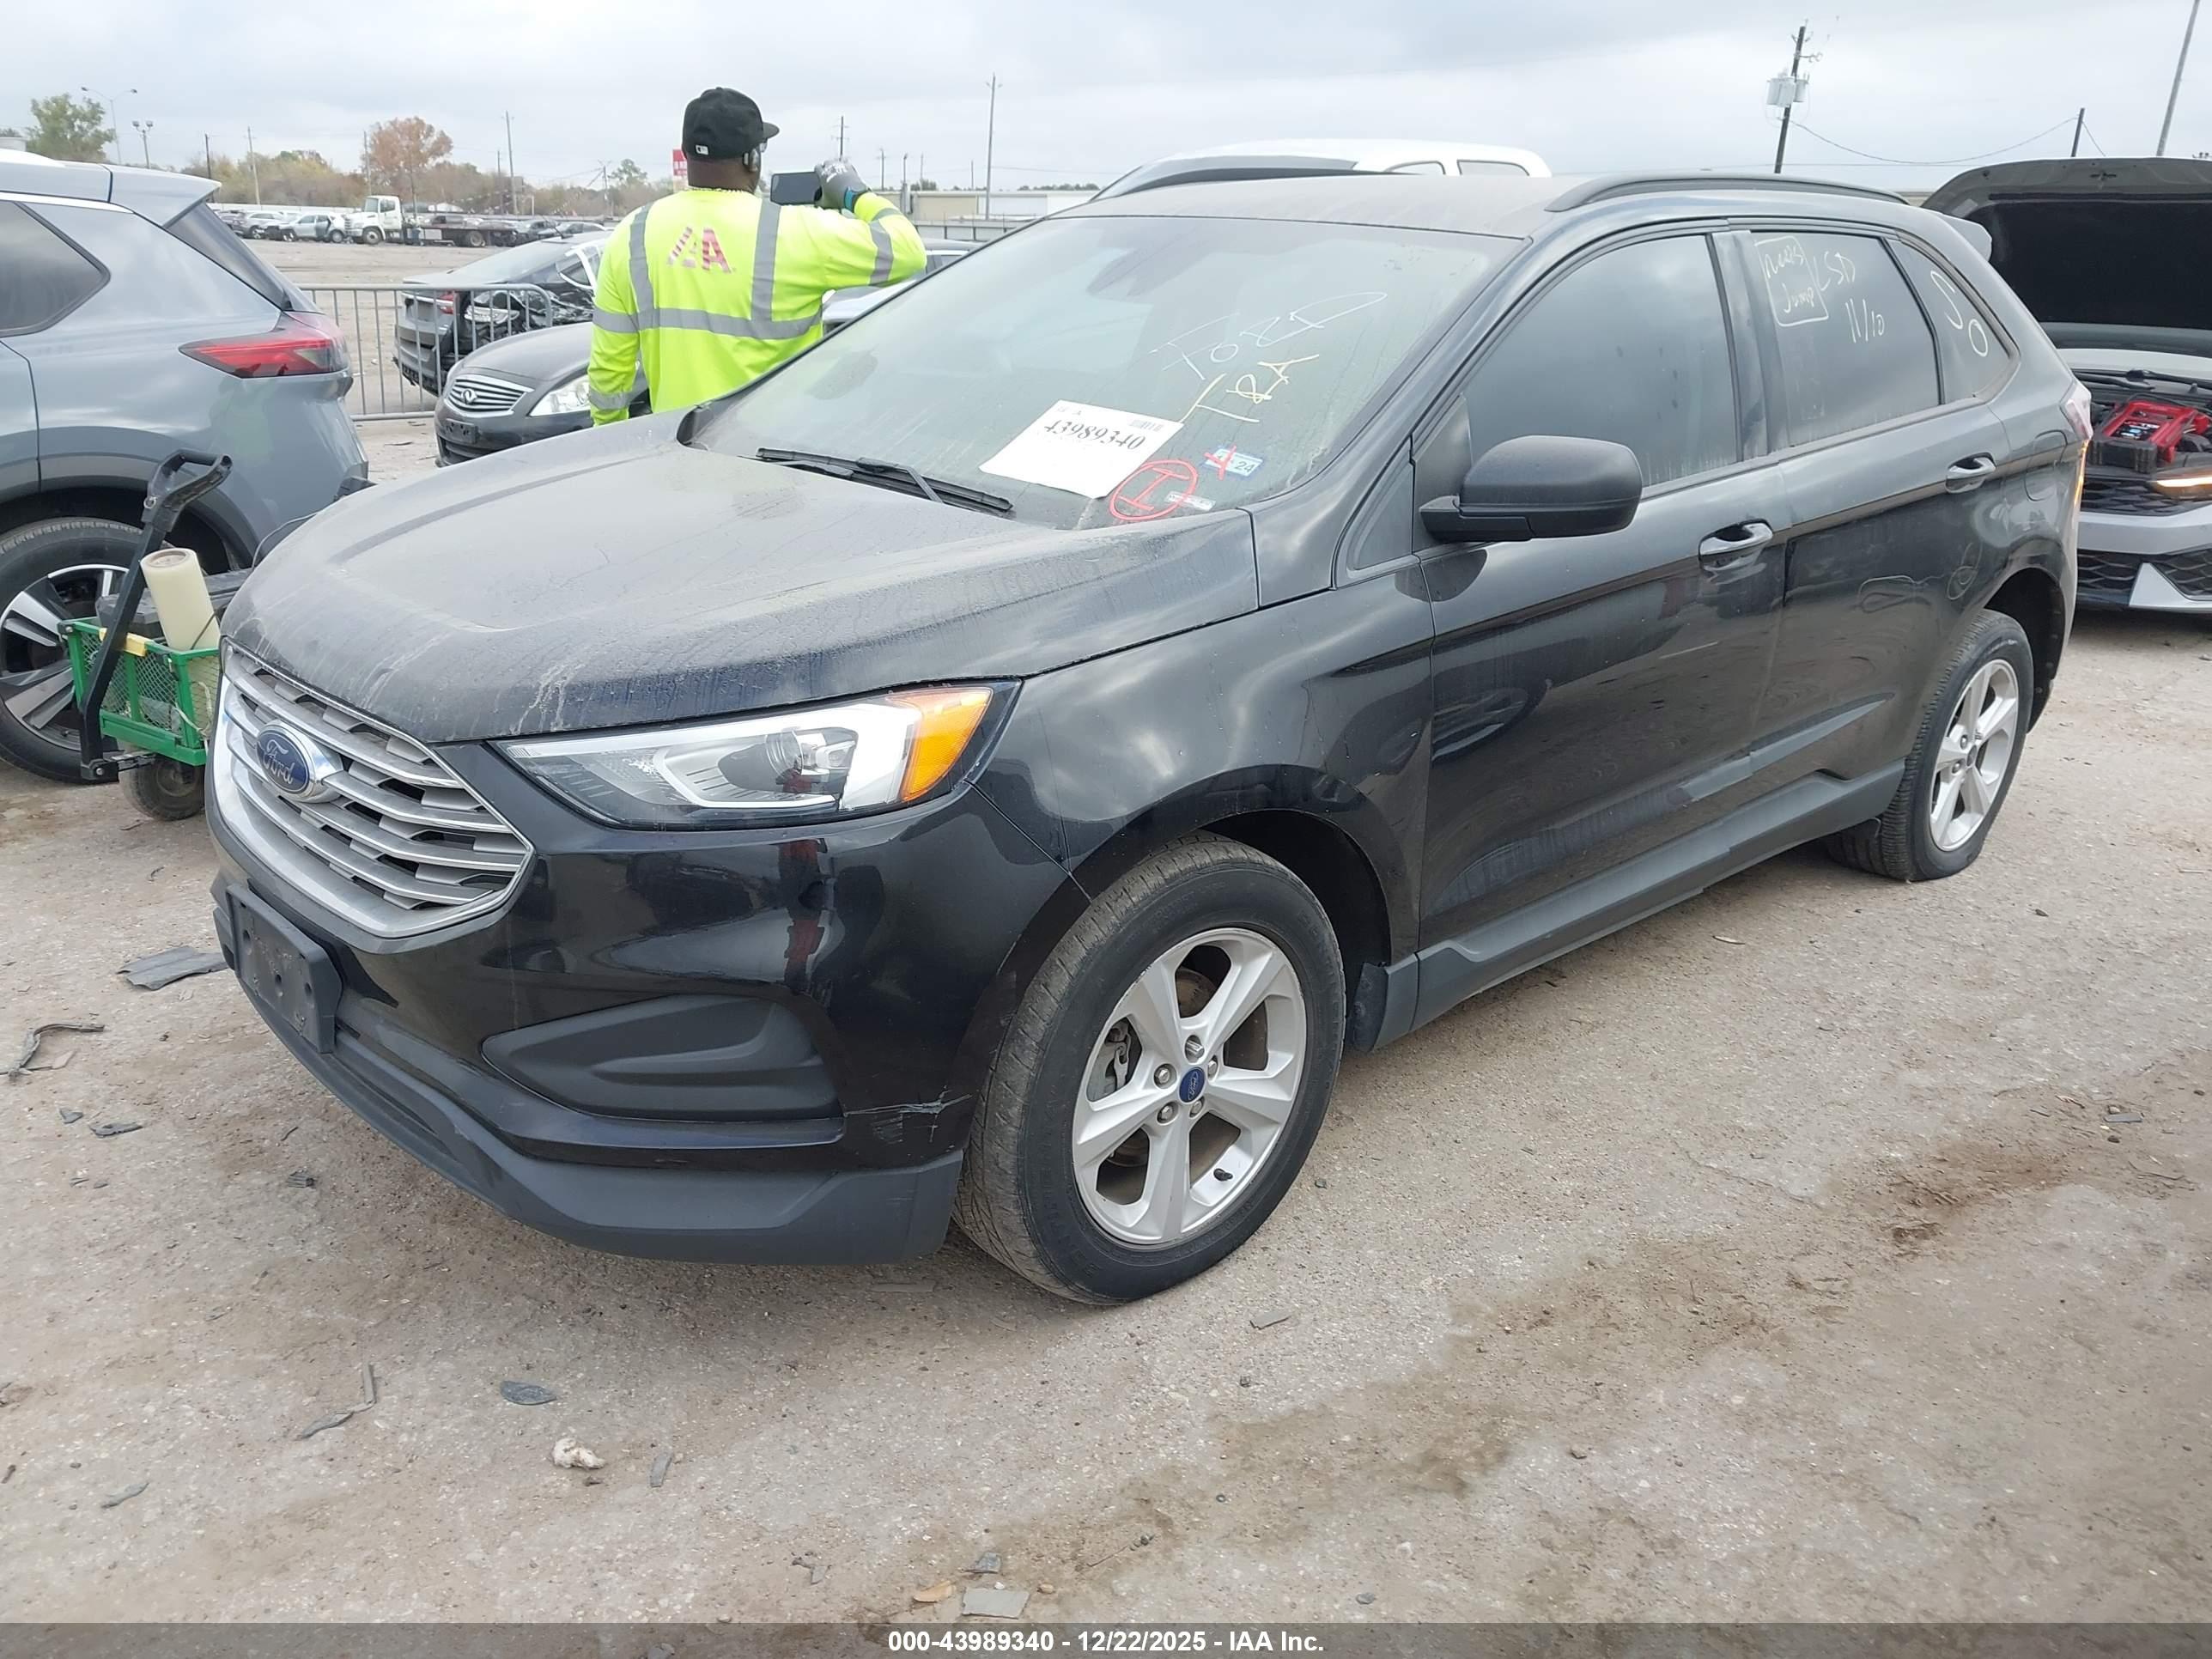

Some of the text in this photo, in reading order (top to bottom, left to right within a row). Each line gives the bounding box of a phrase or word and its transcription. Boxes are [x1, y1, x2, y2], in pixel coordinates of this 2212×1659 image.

[1043, 419, 1146, 450] 43989340
[1234, 460, 1255, 473] 24
[262, 738, 295, 786] Ford
